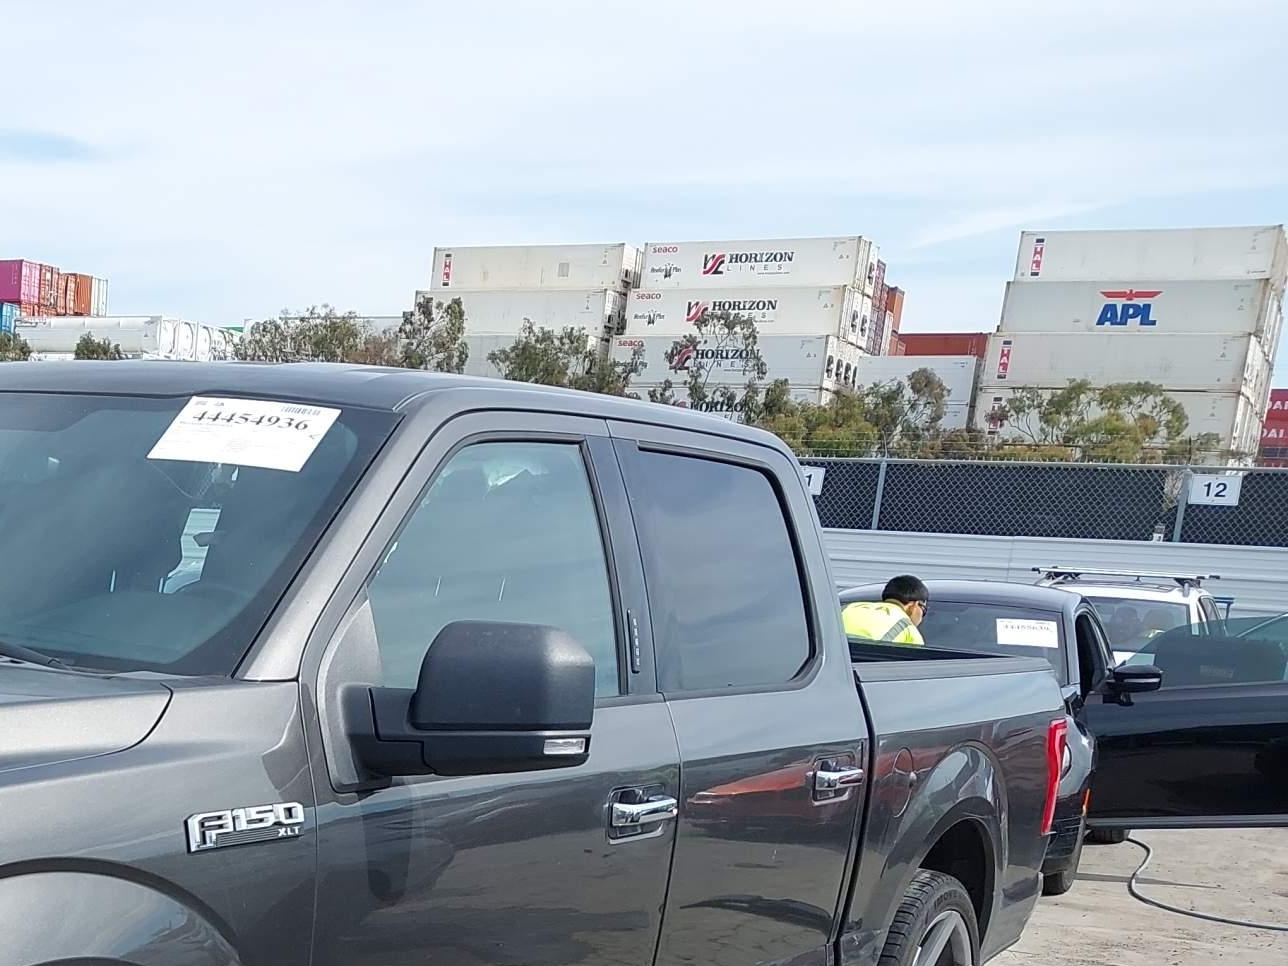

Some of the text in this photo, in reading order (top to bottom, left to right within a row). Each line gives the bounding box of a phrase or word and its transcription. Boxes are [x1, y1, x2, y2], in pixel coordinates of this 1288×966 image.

[652, 246, 678, 254] seaco
[728, 251, 795, 264] HORIZON
[1032, 246, 1044, 270] TAL
[636, 292, 662, 300] seaco
[711, 300, 778, 312] HORIZON
[1095, 303, 1157, 326] APL
[192, 410, 311, 431] 44454936
[1204, 482, 1228, 498] 12
[277, 826, 301, 837] XLT
